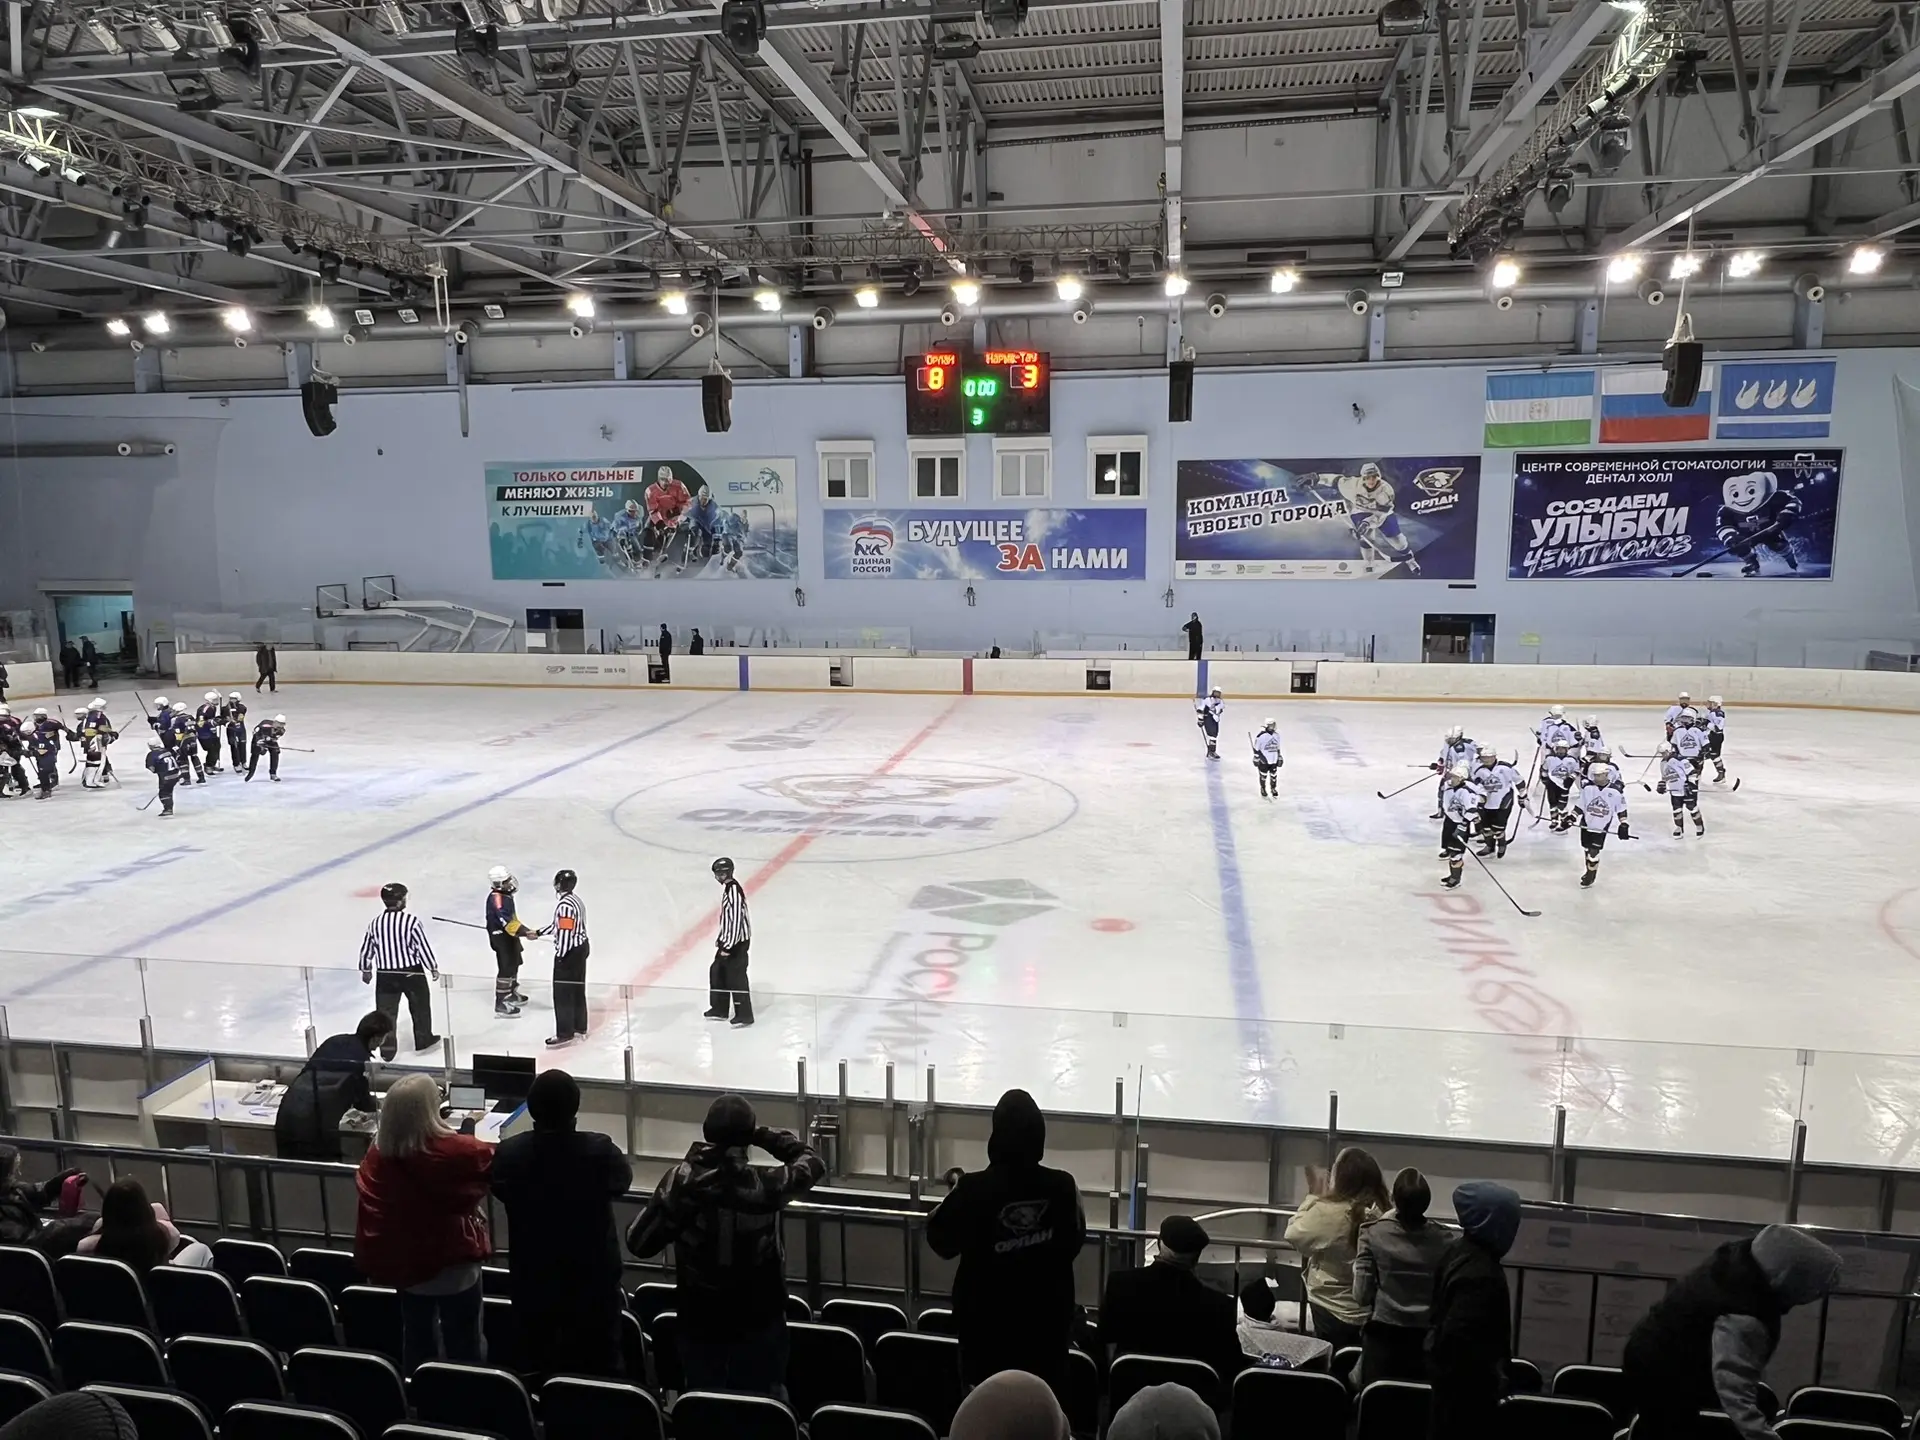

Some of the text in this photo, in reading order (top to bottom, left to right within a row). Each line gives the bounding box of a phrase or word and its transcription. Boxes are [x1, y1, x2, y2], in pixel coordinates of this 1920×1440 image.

[927, 366, 944, 390] 8
[1022, 365, 1038, 389] 3
[972, 407, 984, 426] 3
[513, 469, 635, 483] ТОЛЬКО СИЛЬНЫЕ
[1521, 458, 1766, 474] ЦЕНТР СОВРЕМЕННОЙ СТОМАТОЛОГИИ
[728, 481, 760, 492] БСК
[1585, 471, 1673, 485] ДЕНТАЛ ХОЛЛ
[504, 485, 614, 499] МЕНЯЮТ ЖИЗНЬ
[1188, 488, 1288, 516] КОМАНДА
[1410, 493, 1459, 510] ОРЛАН
[501, 504, 584, 517] К ЛУЧШЕМУ!
[1546, 492, 1669, 516] СОЗДАЕМ
[1188, 500, 1348, 537] ТВОЕГО ГОРОДА
[1529, 506, 1690, 548] УЛЫБКИ
[907, 519, 1024, 547] БУДУЩЕЕ
[852, 557, 892, 566] ЕДИНАЯ
[997, 543, 1128, 572] ЗА НАМИ
[1523, 535, 1693, 577] ЧЕМПИОНОВ
[852, 565, 892, 574] РОССИЯ
[994, 1227, 1054, 1253] ОРЛАН
